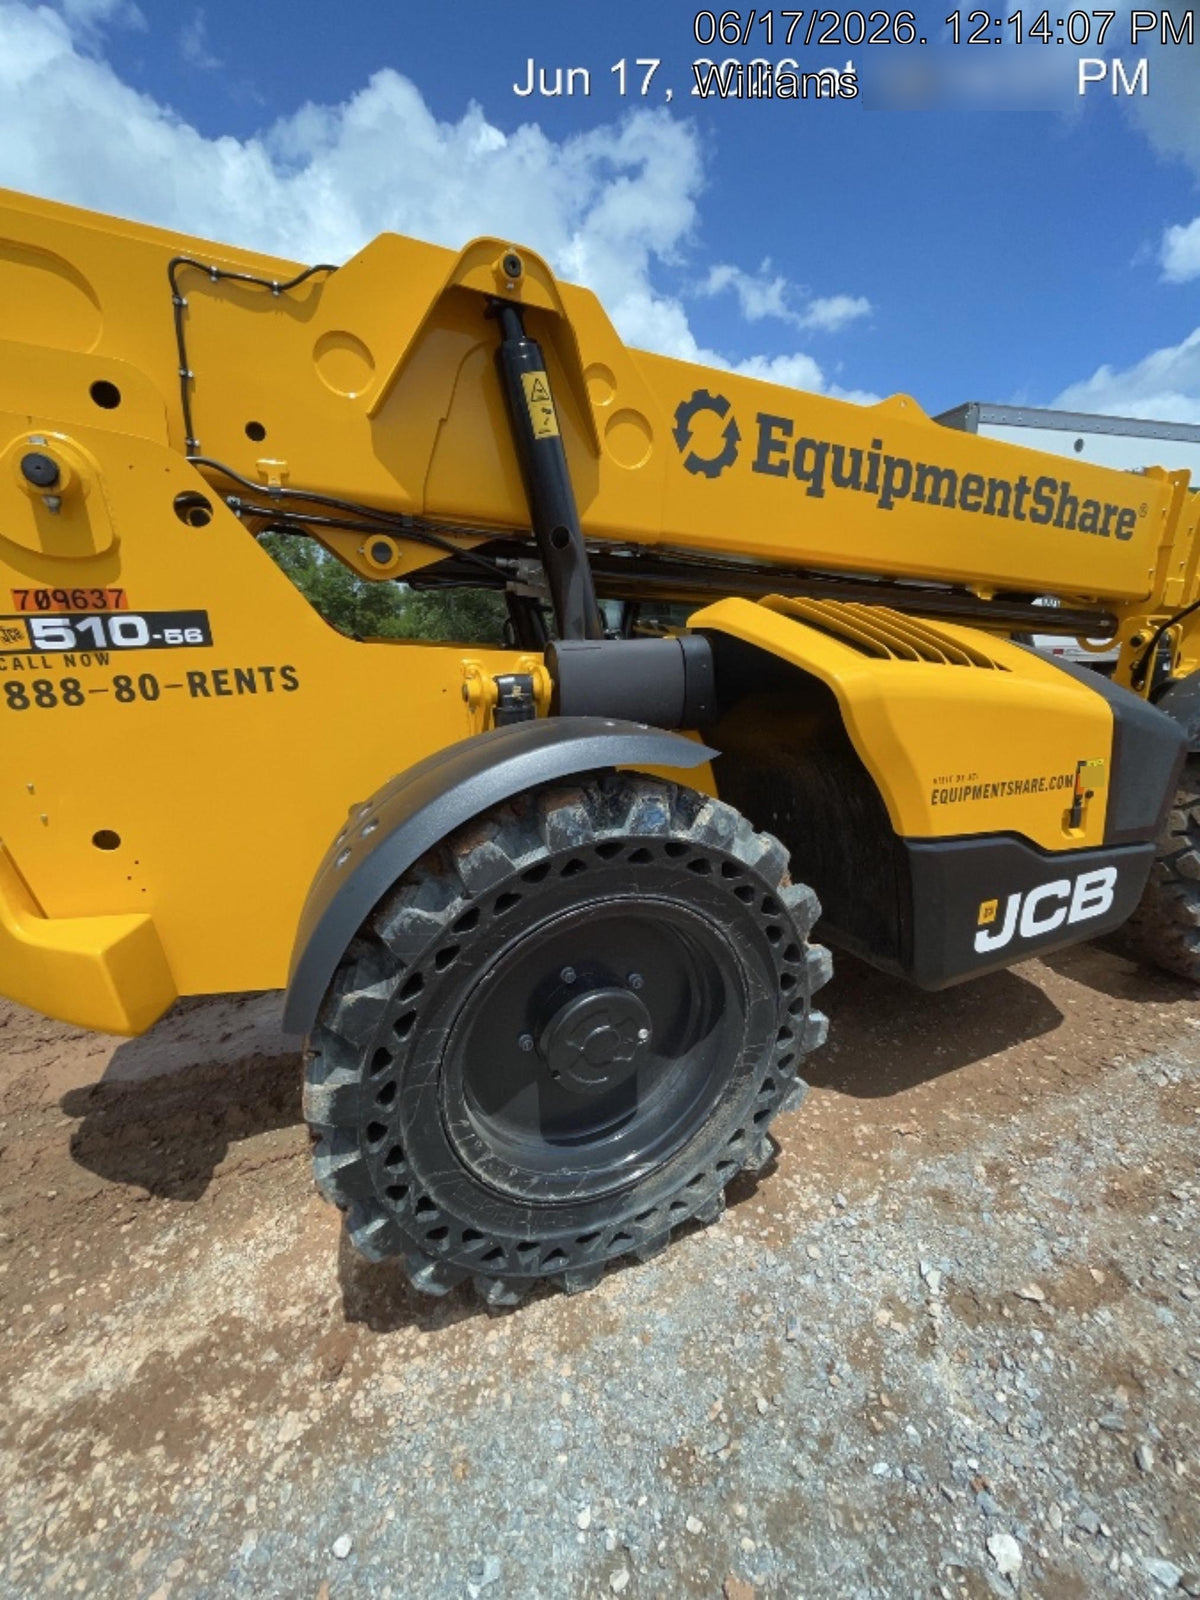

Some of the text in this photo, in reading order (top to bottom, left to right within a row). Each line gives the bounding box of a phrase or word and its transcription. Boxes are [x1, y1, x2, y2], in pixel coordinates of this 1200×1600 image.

[13, 588, 125, 611] 709637
[0, 653, 110, 671] CALL NOW
[3, 665, 300, 711] 888-80-RENTS
[931, 774, 1074, 806] EQUIPMENTSHARE.COM
[974, 866, 1118, 953] JCB
